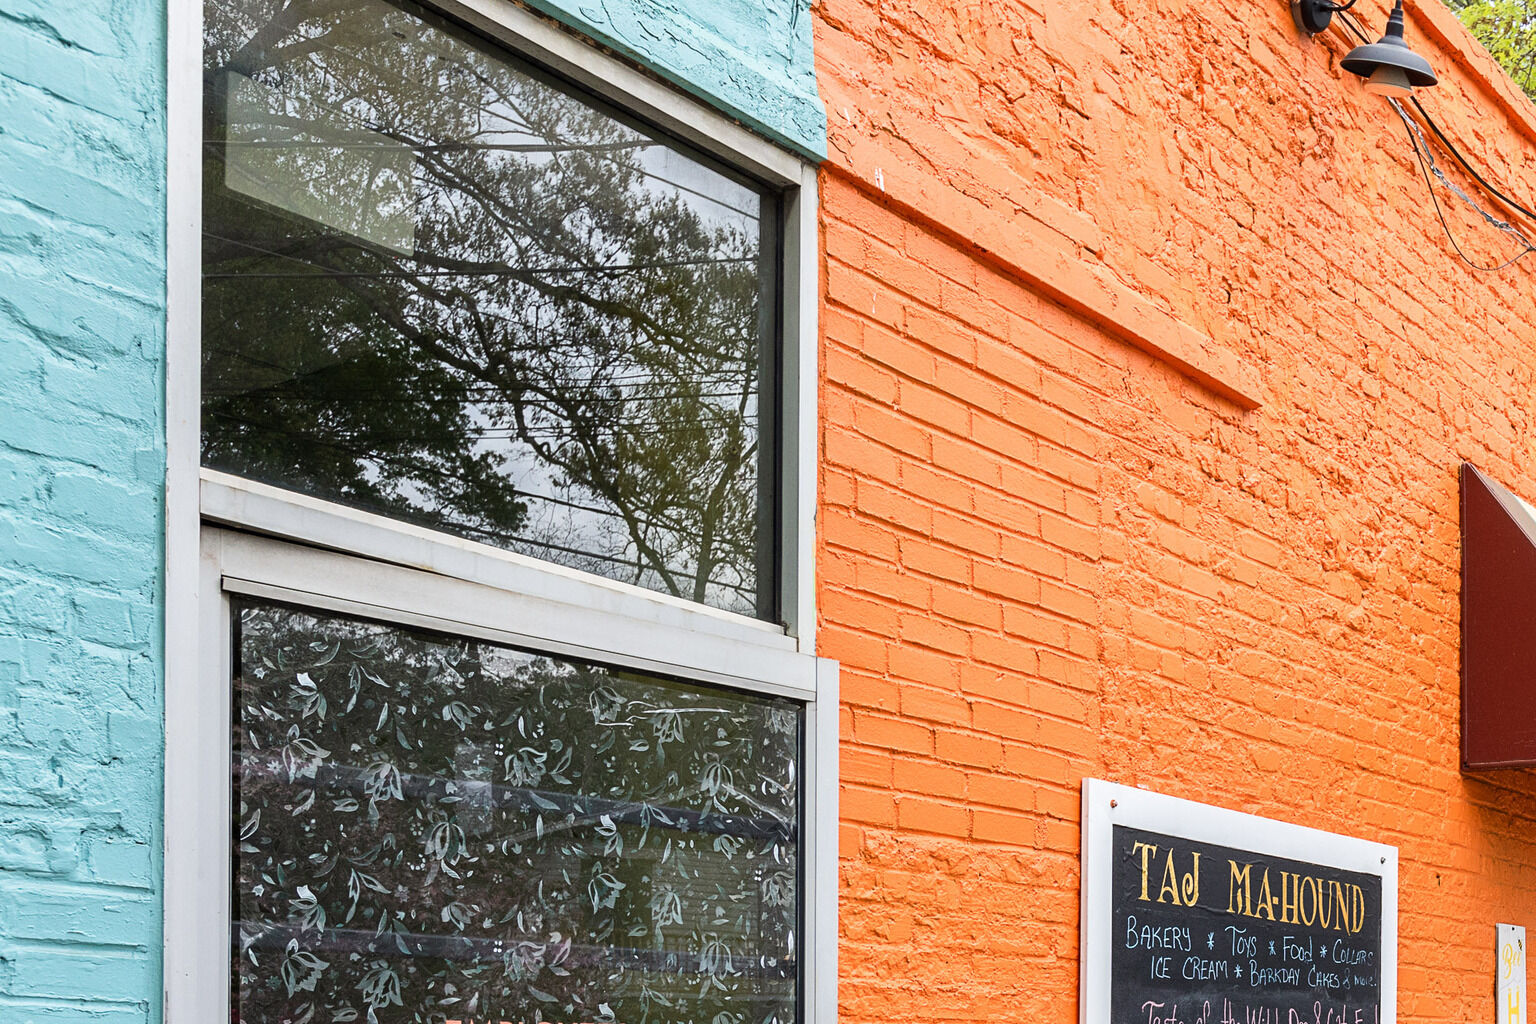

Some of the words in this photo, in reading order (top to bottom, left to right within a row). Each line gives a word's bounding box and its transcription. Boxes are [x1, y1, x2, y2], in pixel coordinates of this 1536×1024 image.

[1132, 840, 1201, 907] TAJ
[1226, 859, 1366, 936] MA-HOUND
[1125, 915, 1192, 951] BAKERY
[1151, 955, 1172, 980] ICE
[1182, 956, 1229, 981] CREAM
[1249, 959, 1300, 987] BARKDAY
[1308, 964, 1340, 988] CAKES
